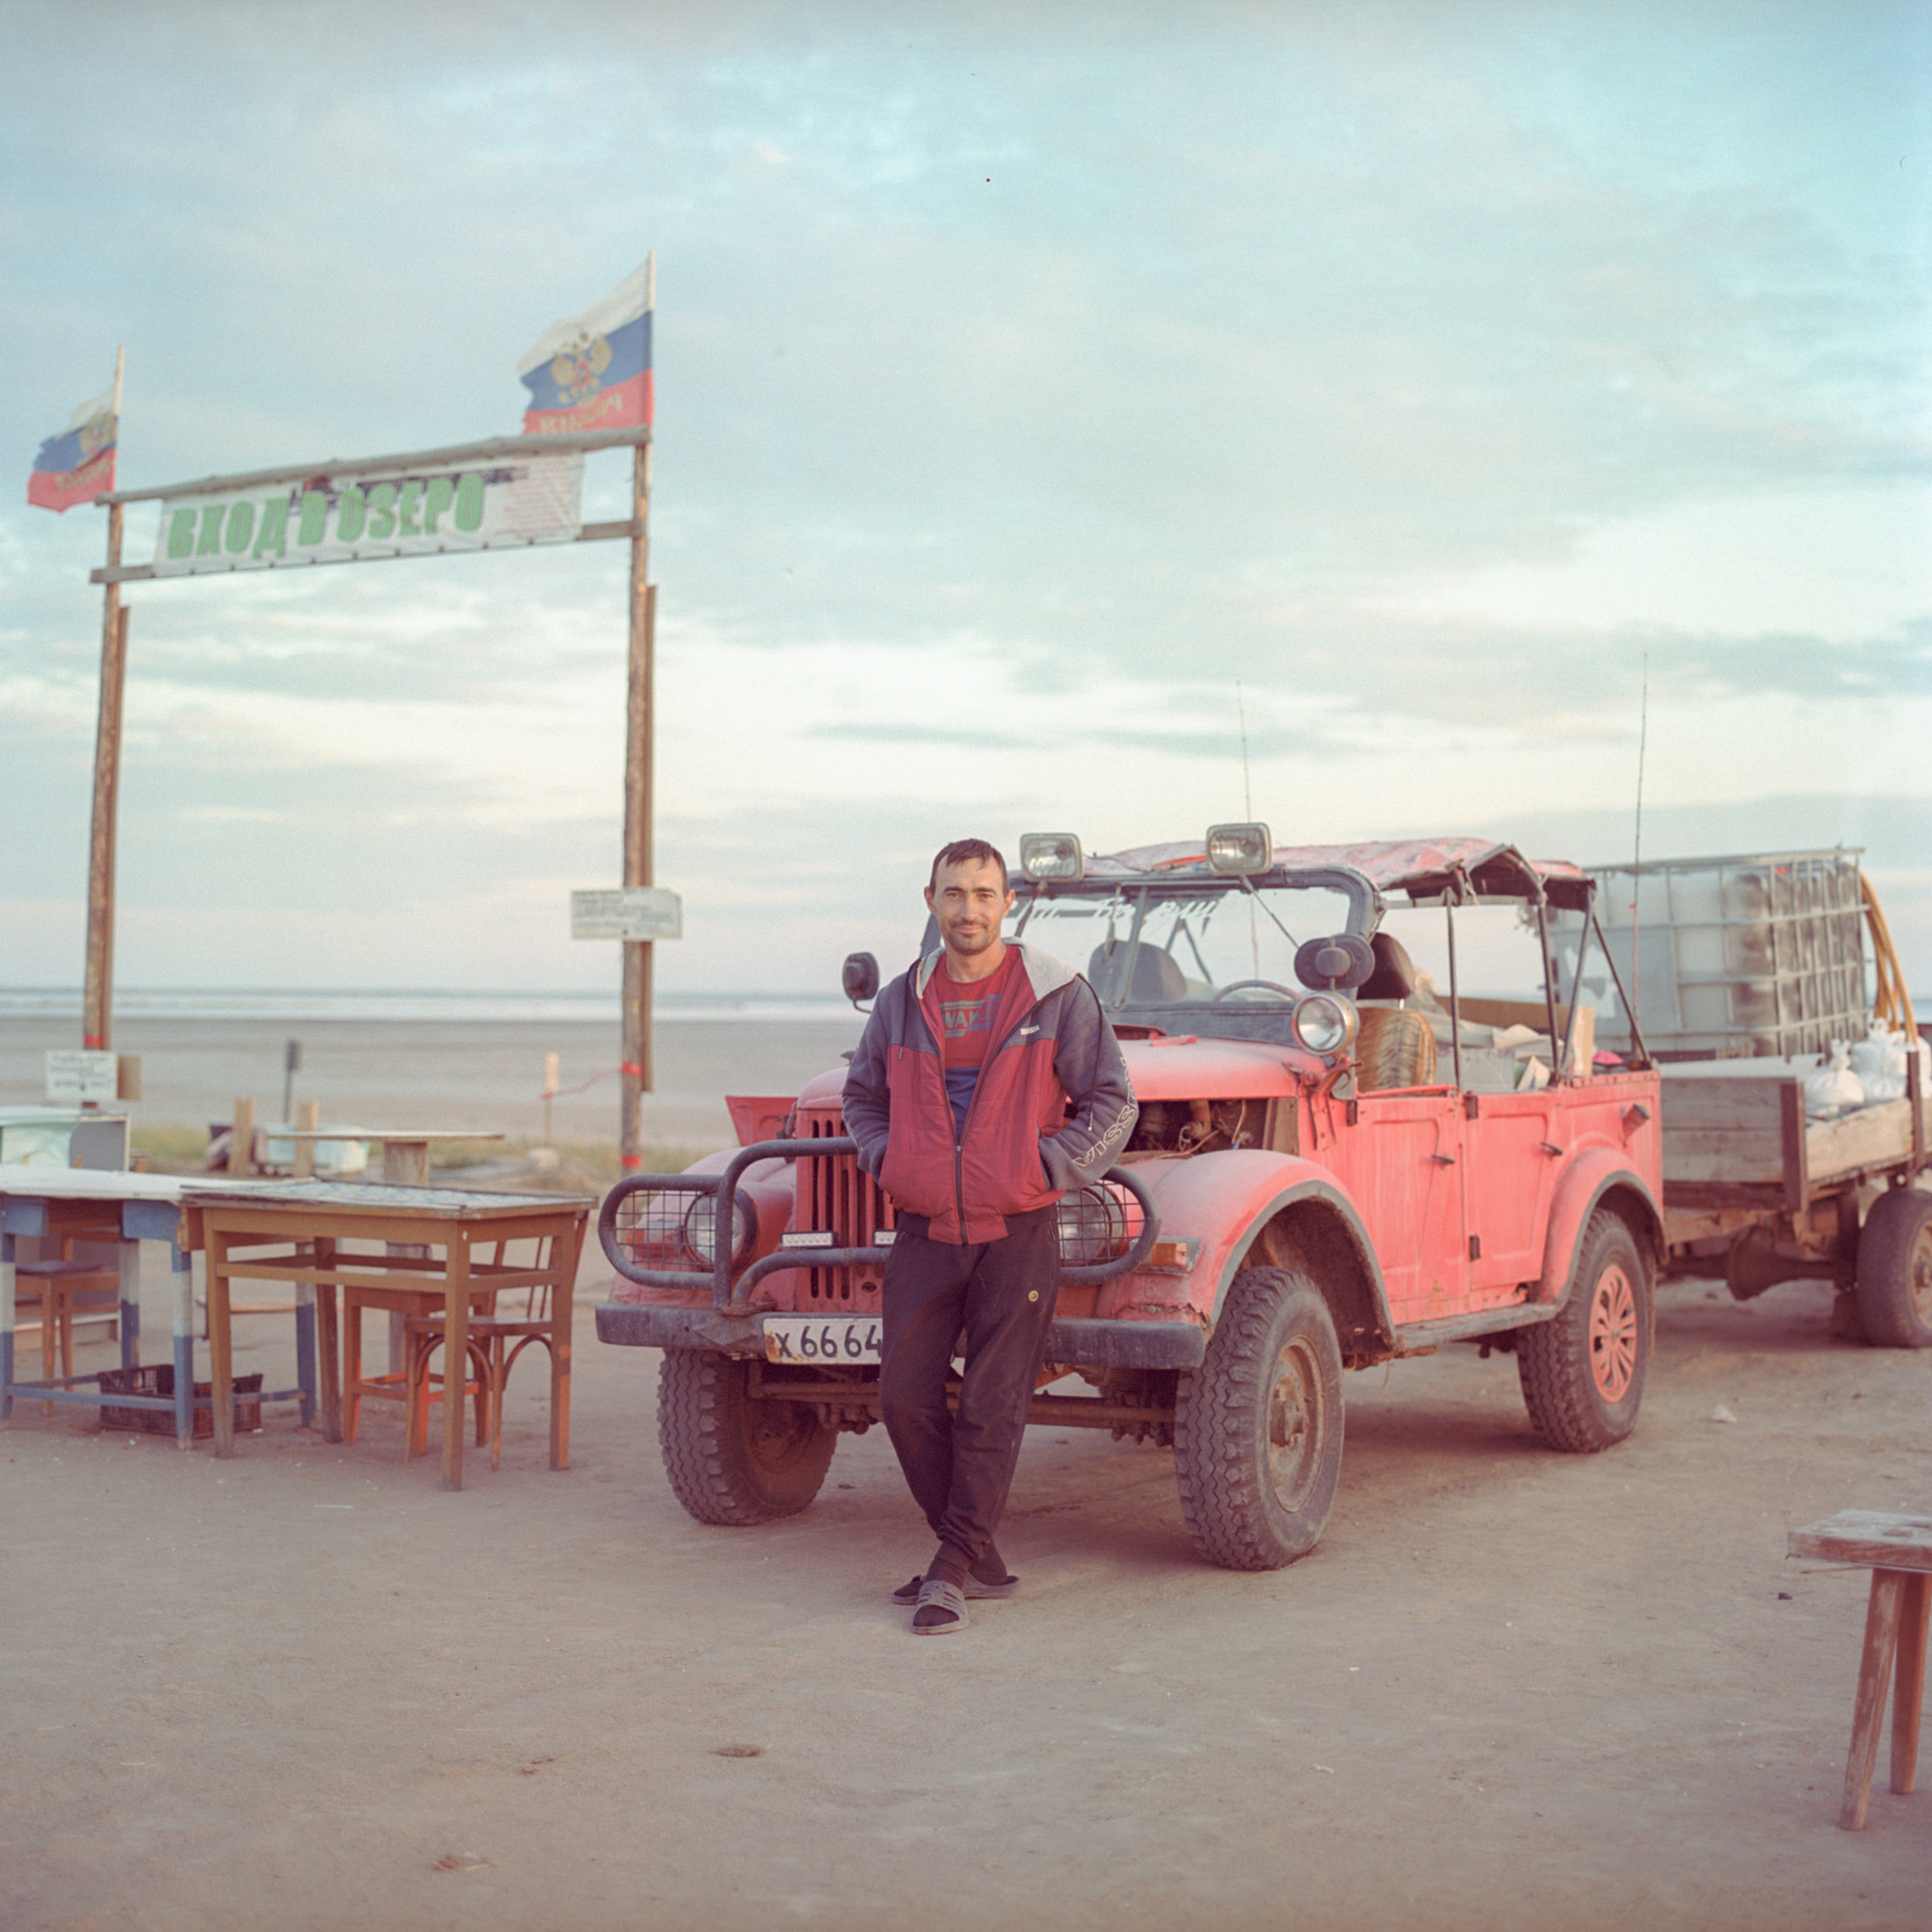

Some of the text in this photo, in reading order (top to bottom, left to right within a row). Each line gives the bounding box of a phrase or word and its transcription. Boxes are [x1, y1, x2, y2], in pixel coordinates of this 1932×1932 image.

[166, 497, 291, 559] ВХОД
[297, 491, 328, 546] В
[337, 473, 485, 543] ОЗЕРО
